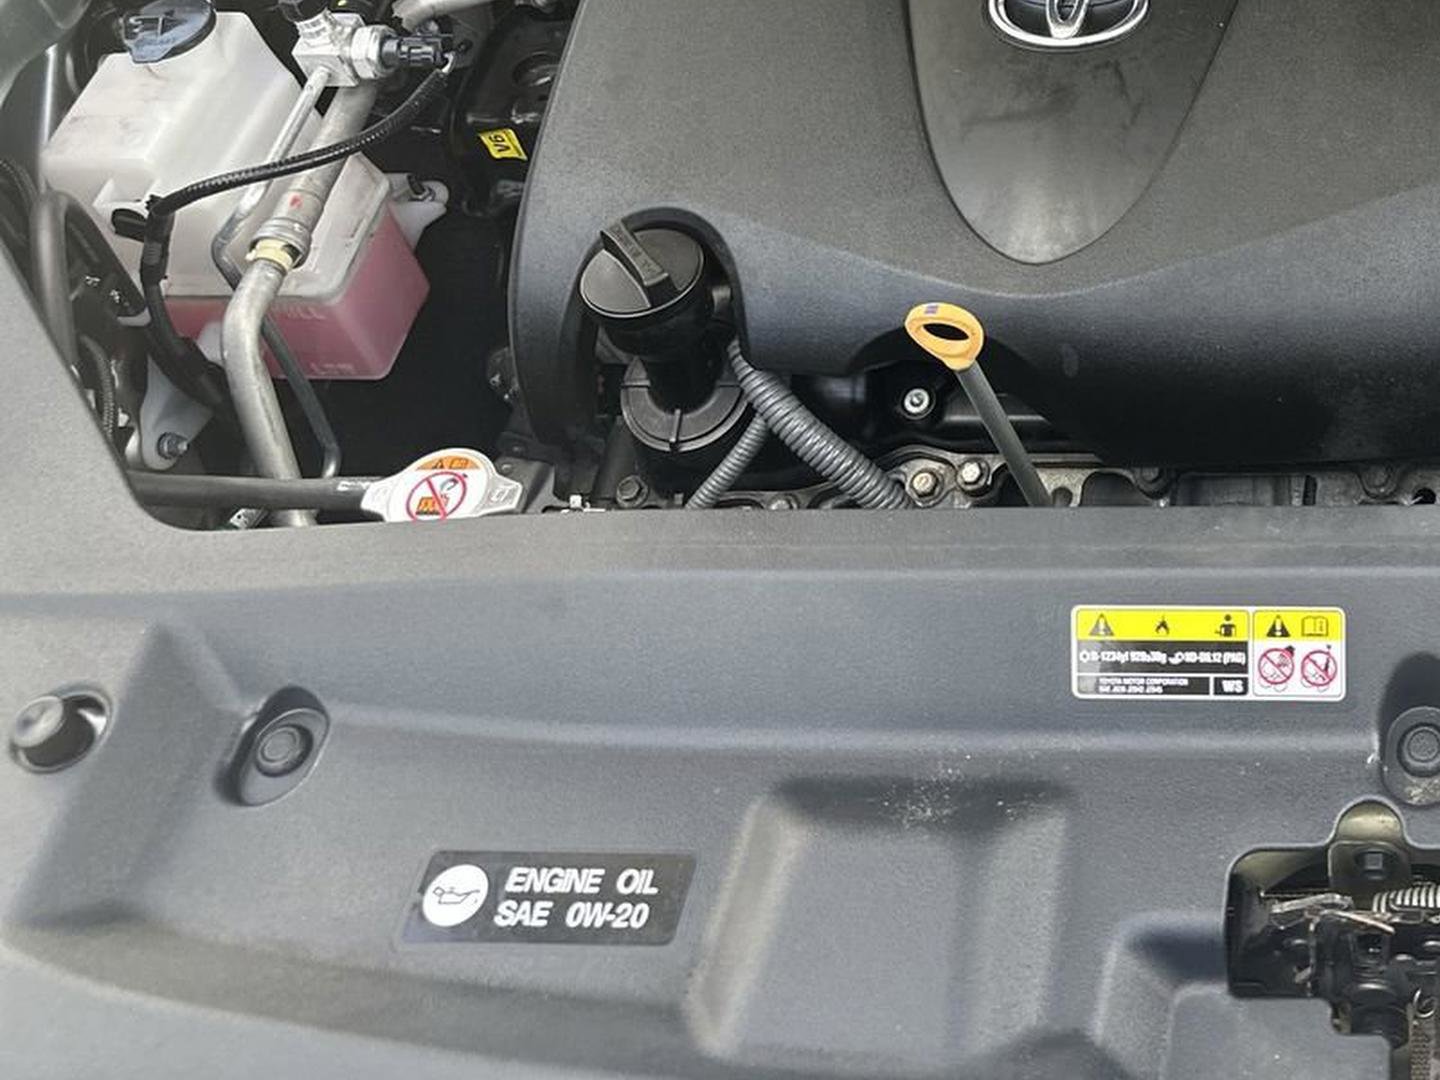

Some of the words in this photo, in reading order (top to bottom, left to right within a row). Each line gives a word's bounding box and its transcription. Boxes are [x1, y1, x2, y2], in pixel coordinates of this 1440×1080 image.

[489, 135, 510, 152] V6
[504, 867, 605, 894] ENGINE
[616, 868, 659, 895] OIL
[494, 899, 554, 927] SAE
[566, 901, 650, 929] 0W-20
